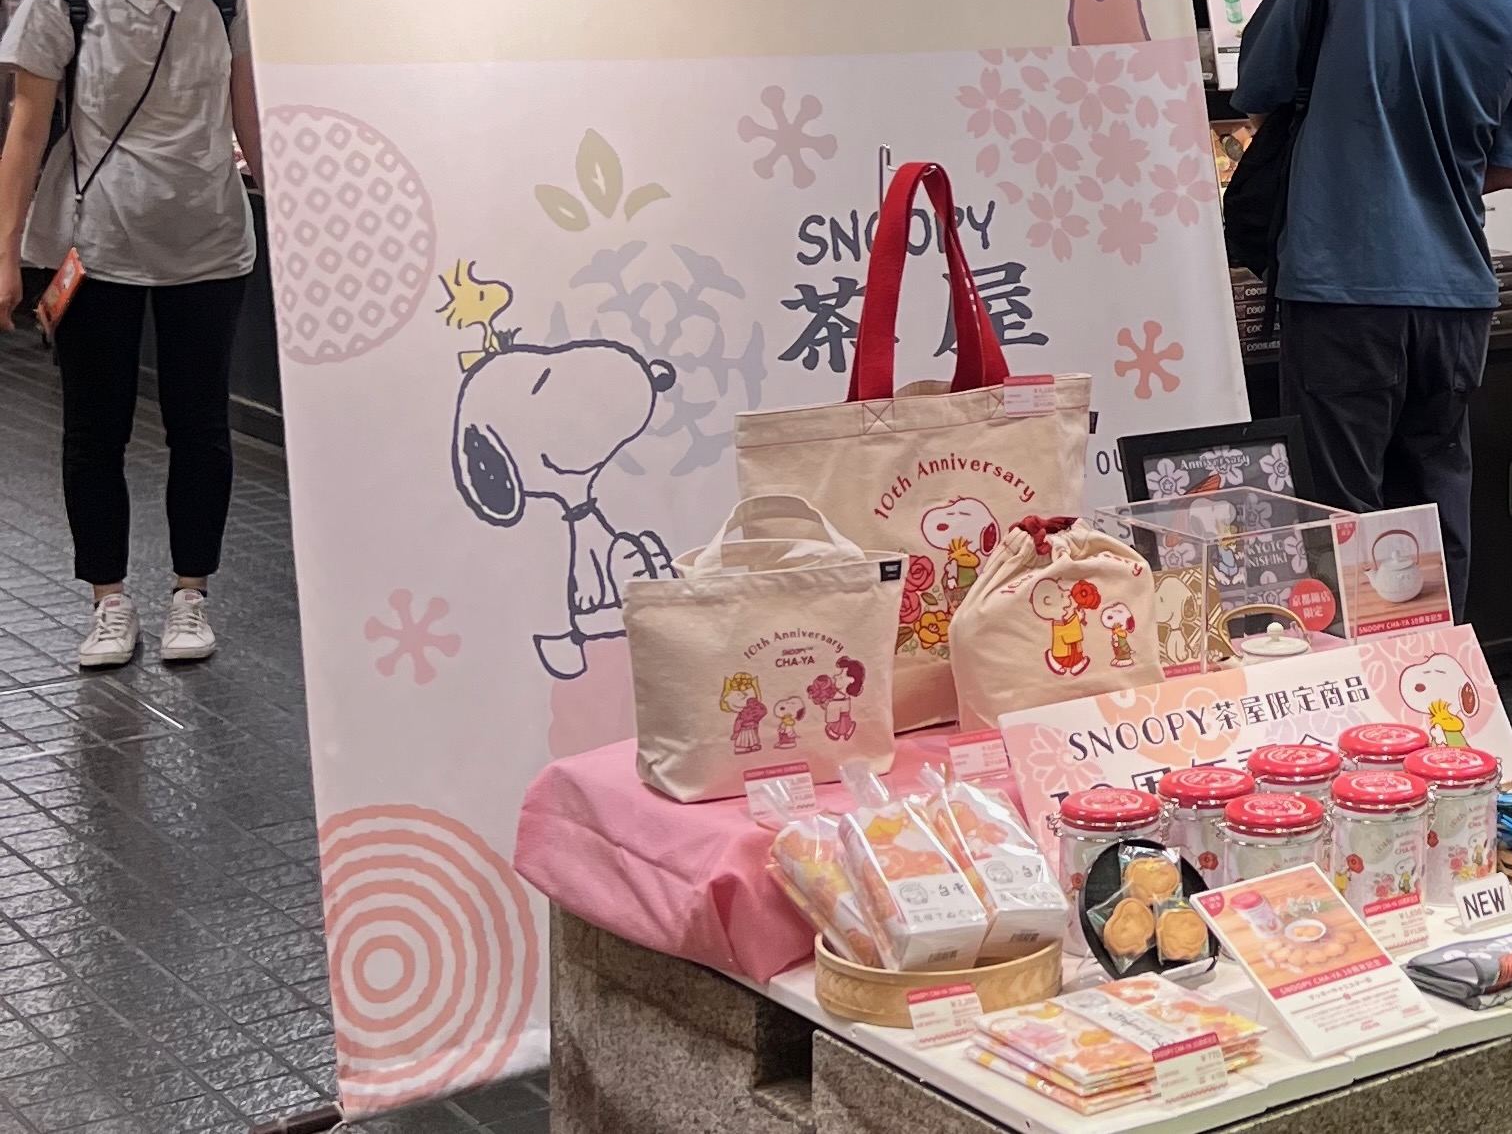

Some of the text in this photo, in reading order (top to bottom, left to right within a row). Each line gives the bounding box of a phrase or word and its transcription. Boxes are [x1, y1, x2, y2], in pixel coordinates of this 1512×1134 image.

[1180, 454, 1251, 470] Anniversary
[874, 452, 1036, 520] 10th Anniversary
[774, 628, 844, 654] Anniversary
[775, 655, 815, 668] CHA-YA
[1462, 886, 1507, 921] NEW
